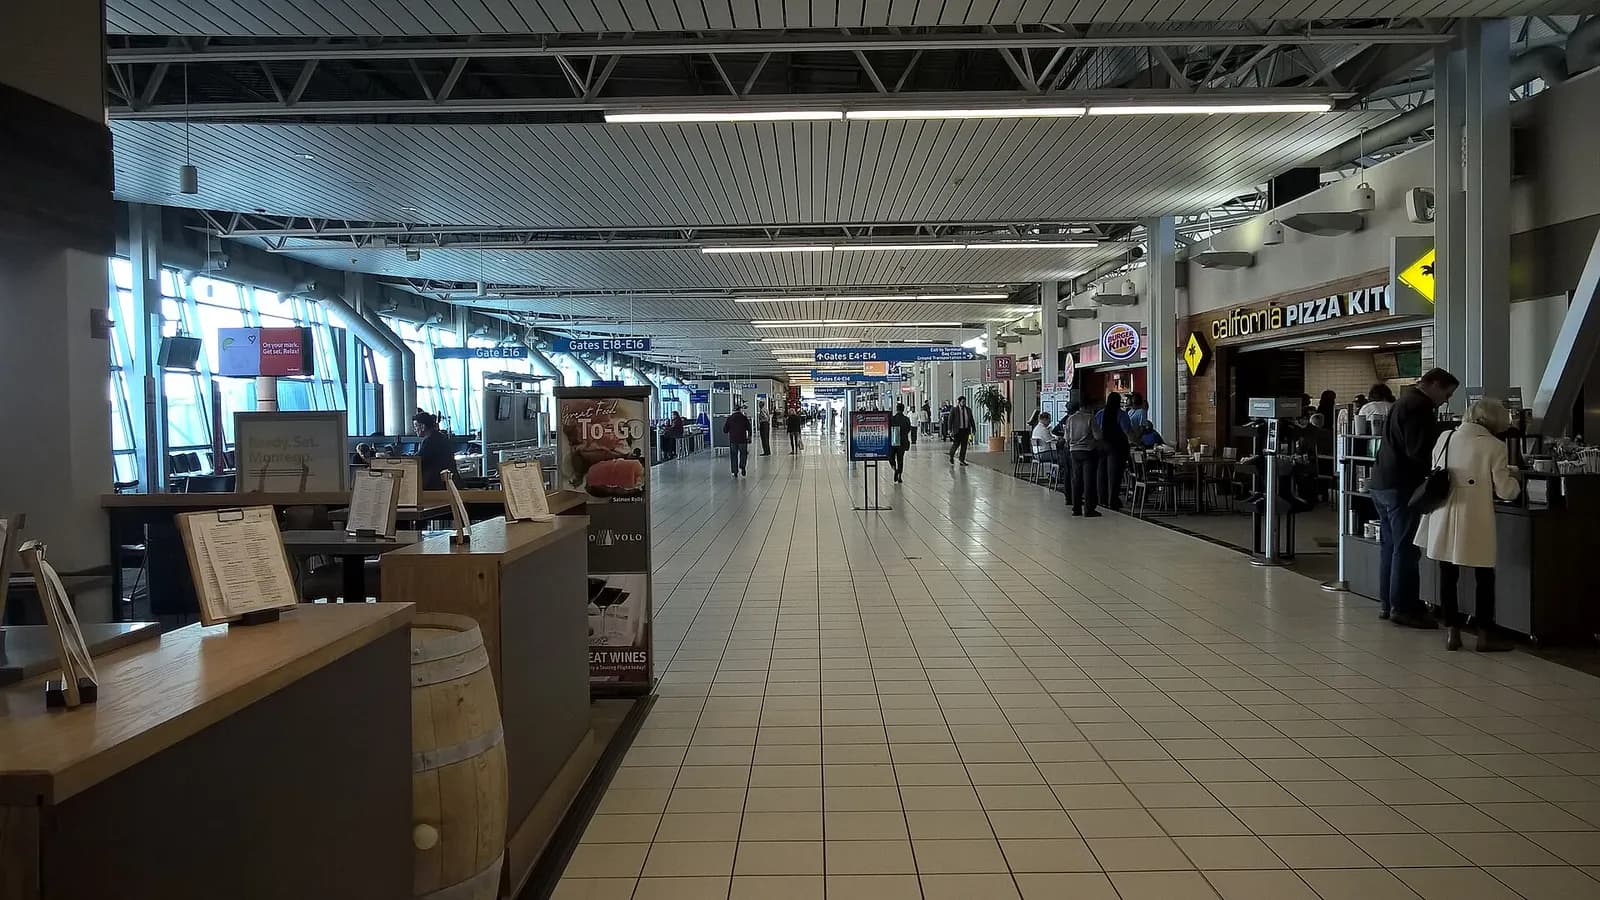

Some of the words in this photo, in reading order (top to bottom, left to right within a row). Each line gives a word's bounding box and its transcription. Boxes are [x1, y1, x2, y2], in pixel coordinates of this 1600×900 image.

[1211, 301, 1281, 339] california
[1286, 295, 1341, 327] PIZZA
[1108, 331, 1134, 343] BURGER
[569, 340, 600, 350] Gates
[603, 339, 645, 350] E18-E16
[1108, 336, 1135, 351] KING
[476, 349, 499, 358] Gate
[503, 349, 520, 358] E16
[824, 353, 847, 361] Gates
[609, 651, 647, 663] WINES
